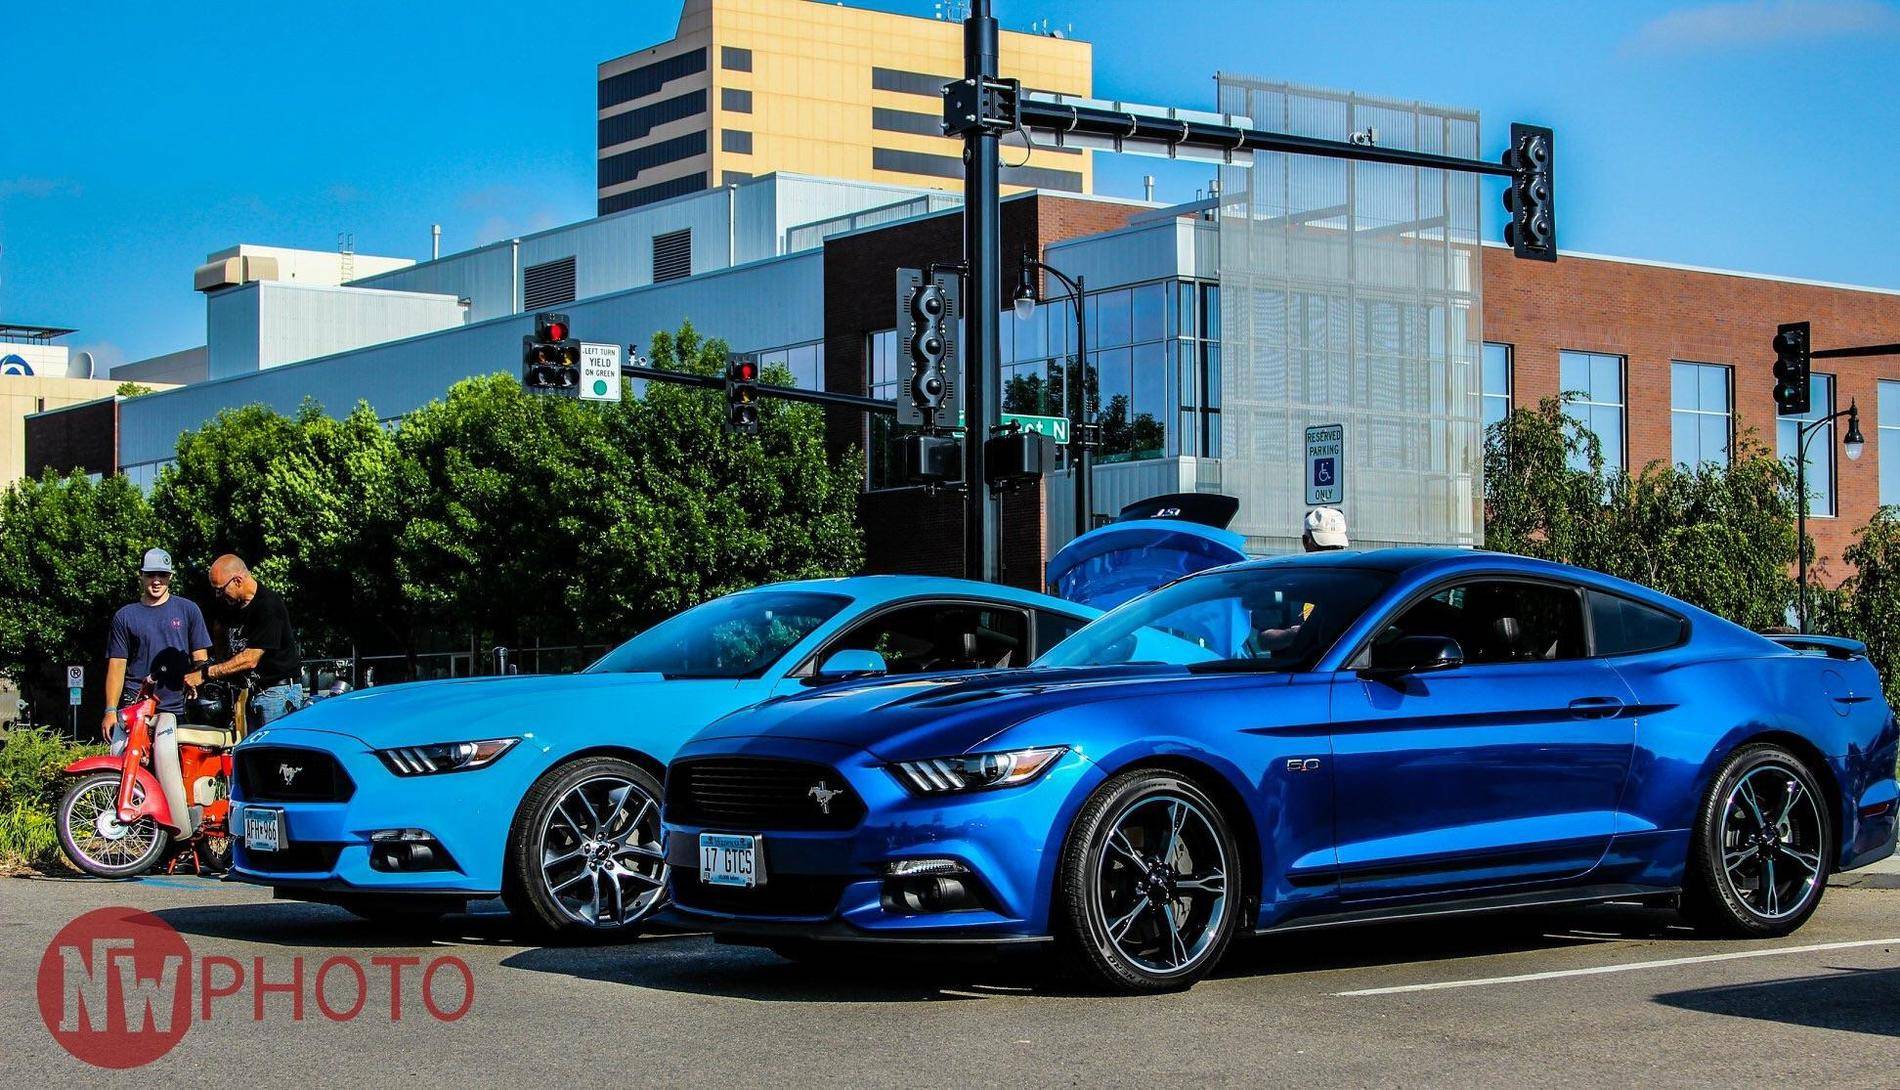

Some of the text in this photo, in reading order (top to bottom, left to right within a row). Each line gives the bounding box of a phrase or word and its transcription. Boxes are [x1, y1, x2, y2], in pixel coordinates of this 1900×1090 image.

[584, 347, 616, 356] LEFT TURN
[589, 357, 611, 368] YIELD
[585, 368, 615, 377] ON GREEN
[1053, 420, 1066, 440] N
[1307, 430, 1341, 443] RESERVED
[1309, 444, 1339, 457] PARKING
[1315, 488, 1333, 500] ONLY
[705, 847, 752, 875] 17 GTCS
